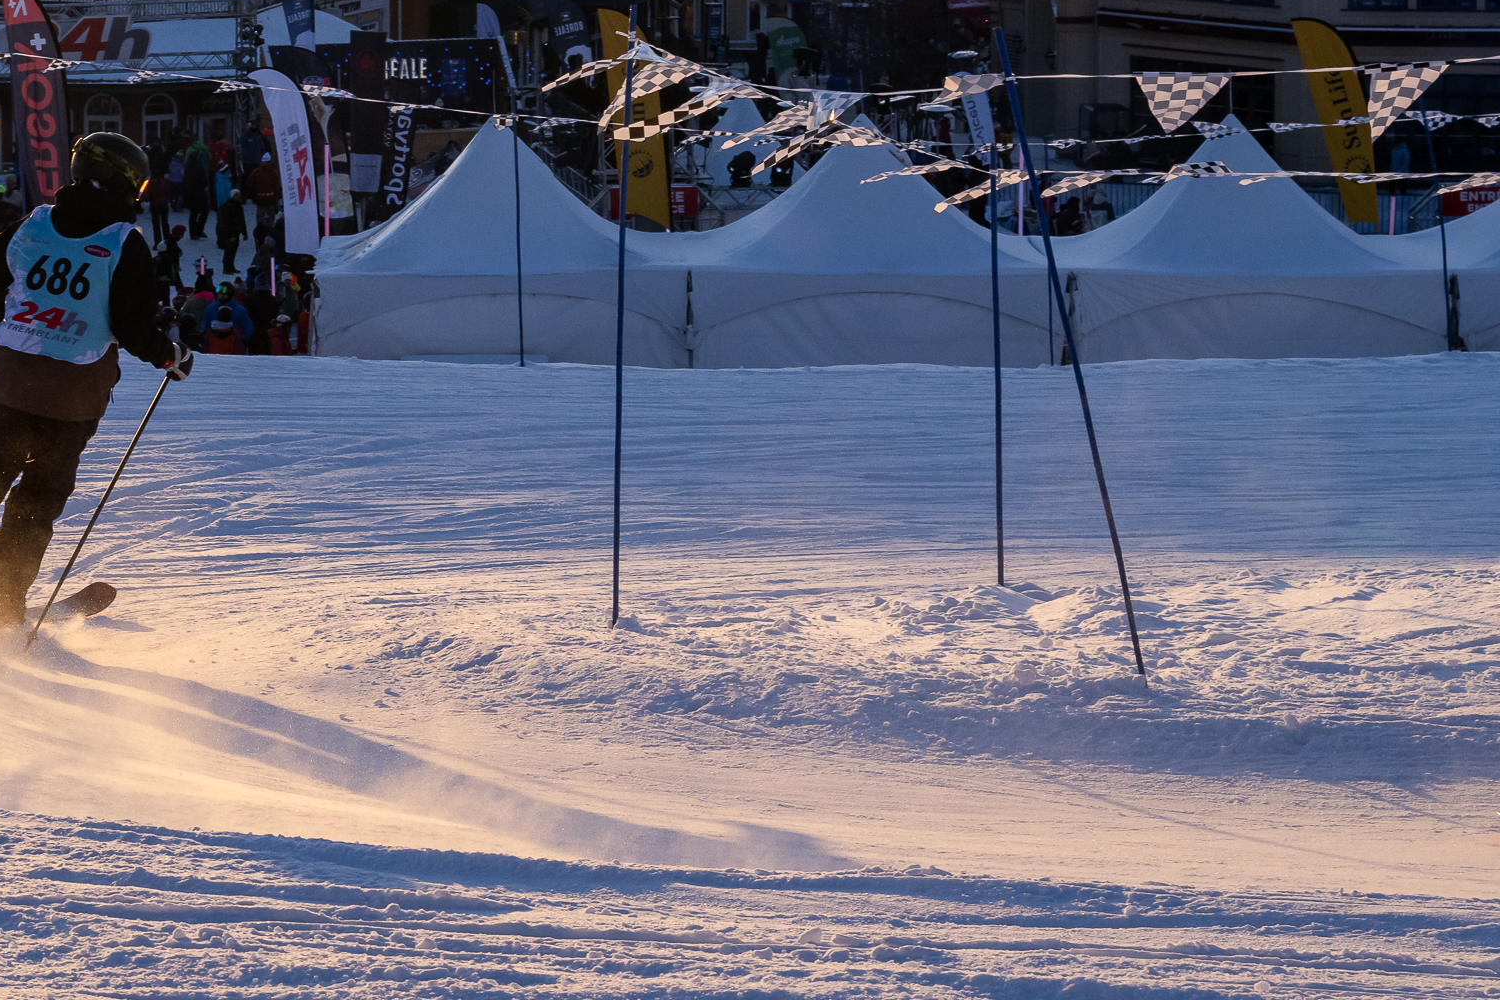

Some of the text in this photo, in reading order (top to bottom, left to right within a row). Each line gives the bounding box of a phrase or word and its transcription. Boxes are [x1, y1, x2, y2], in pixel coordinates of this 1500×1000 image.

[26, 255, 91, 300] 686
[7, 323, 80, 345] TREMBLANT
[12, 301, 88, 337] 24h
